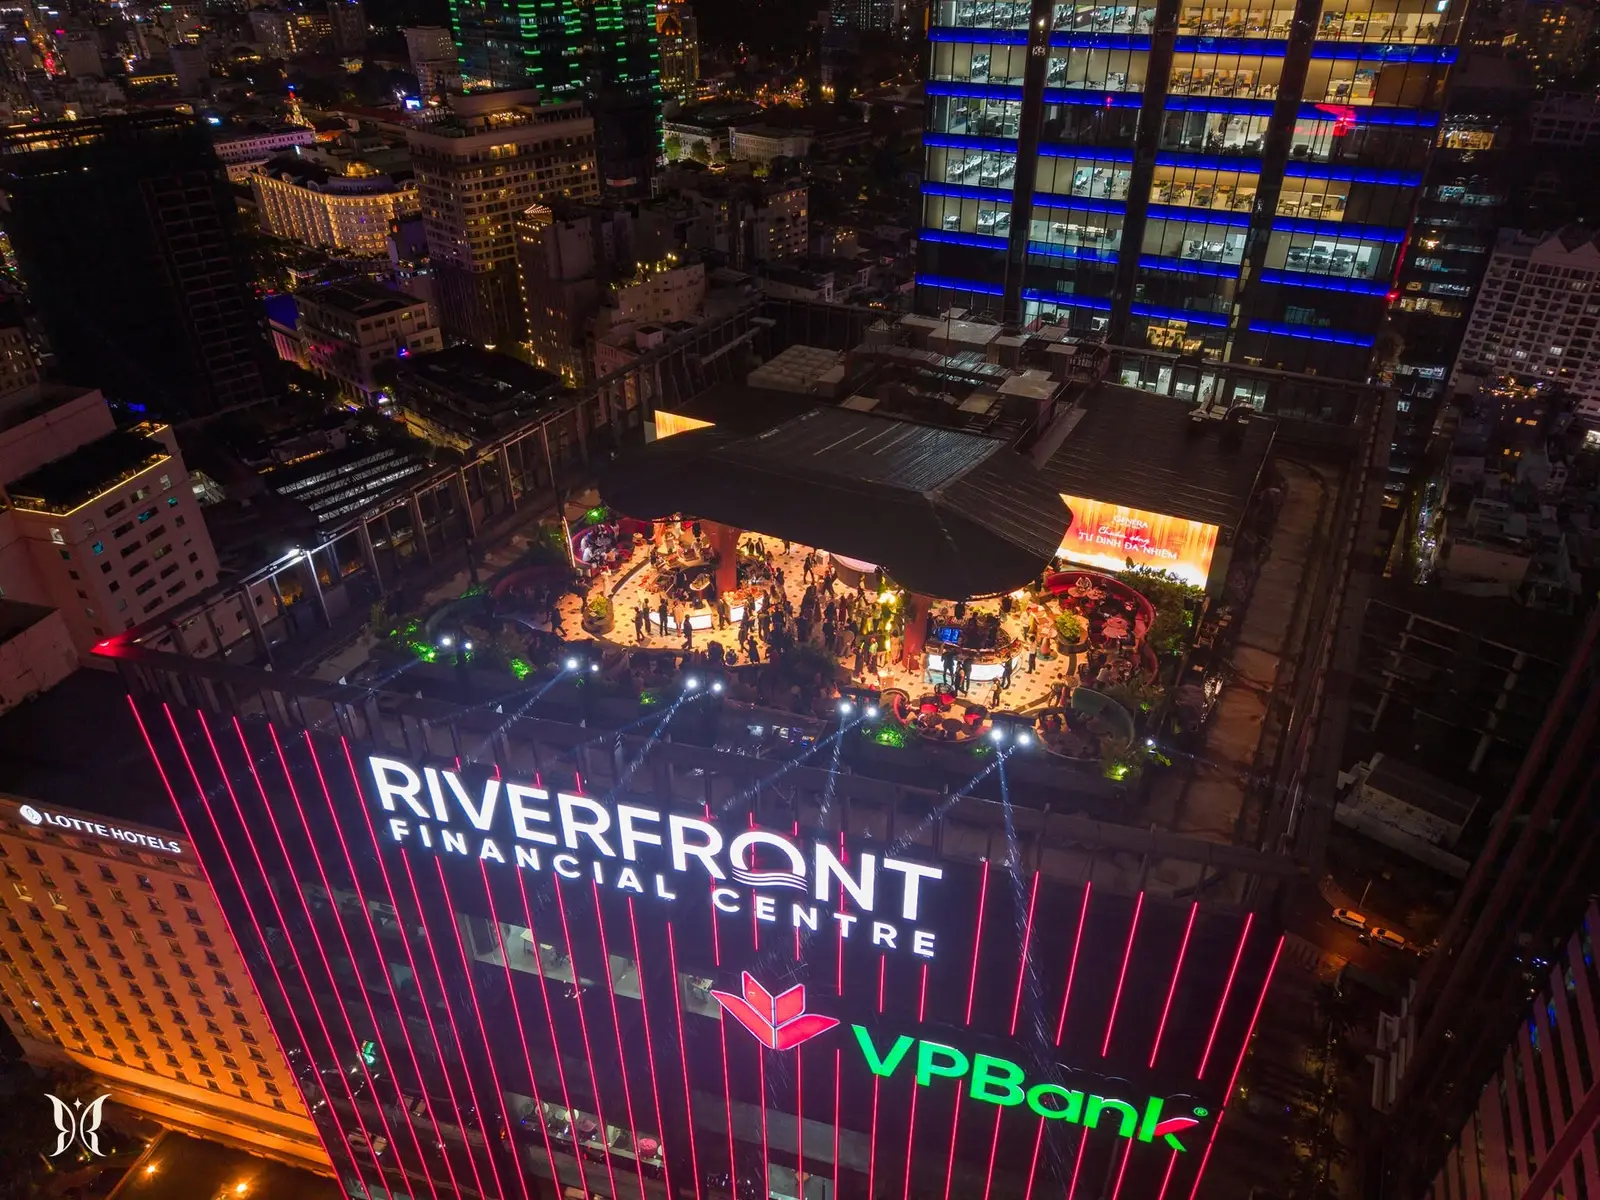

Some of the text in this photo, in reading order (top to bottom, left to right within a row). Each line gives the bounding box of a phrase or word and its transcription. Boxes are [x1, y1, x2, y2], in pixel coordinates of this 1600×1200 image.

[43, 812, 182, 854] LOTTE HOTELS
[367, 755, 943, 921] RIVERFRONT
[389, 818, 937, 957] FINANCIAL CENTRE
[850, 1023, 1199, 1153] VPBank
